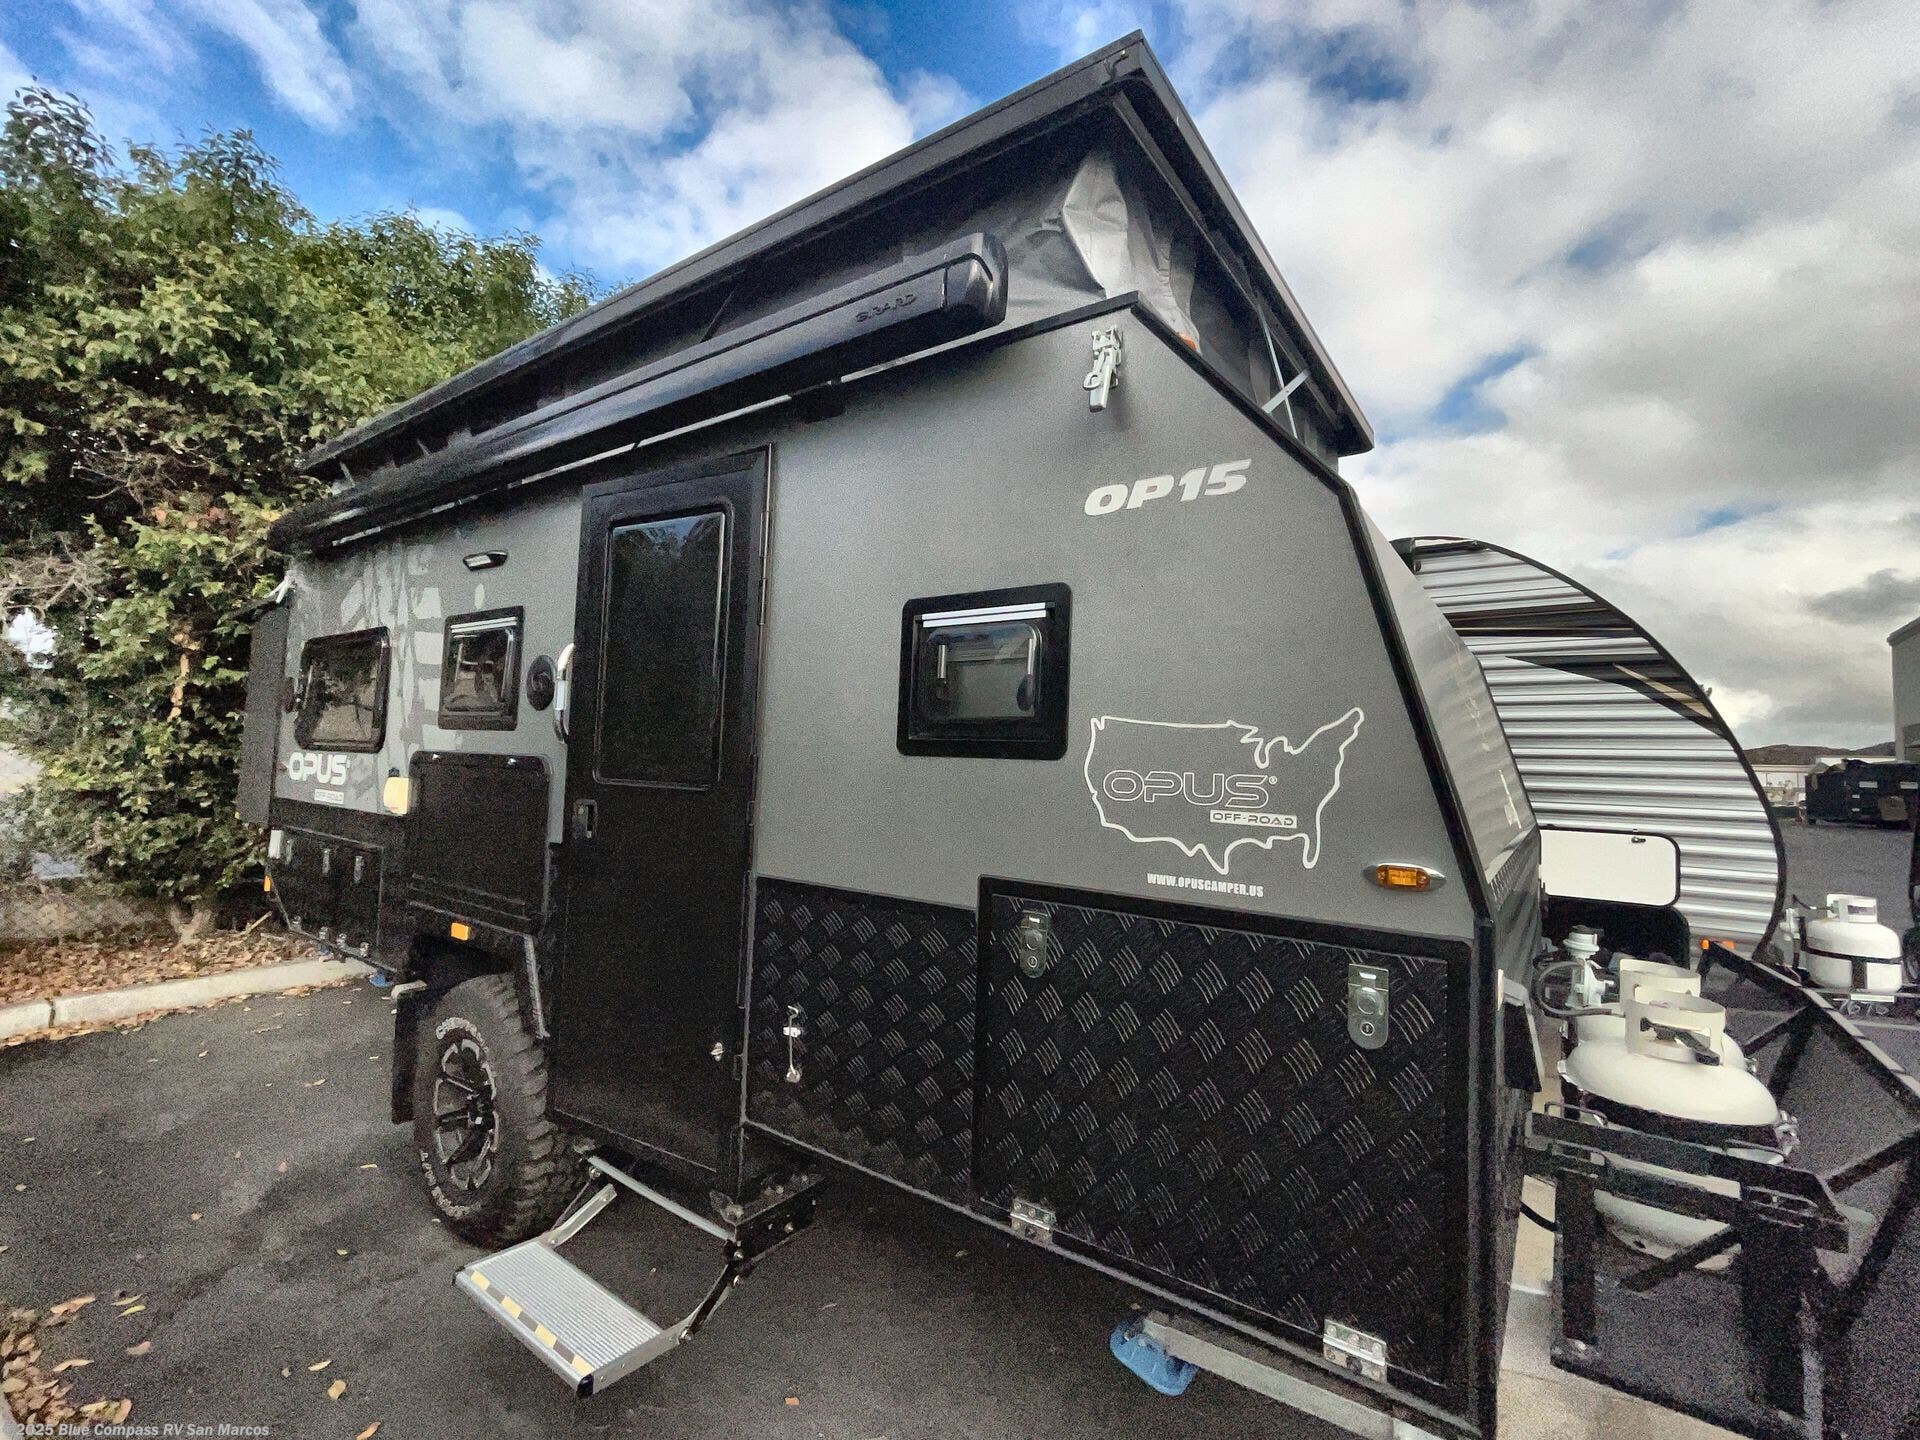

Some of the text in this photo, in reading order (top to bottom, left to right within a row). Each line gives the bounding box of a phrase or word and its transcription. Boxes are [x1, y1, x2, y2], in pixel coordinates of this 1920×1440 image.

[1084, 458, 1252, 516] OP15
[289, 752, 347, 785] OPUS
[1212, 812, 1295, 826] OFF-ROAD
[1146, 873, 1264, 897] WWW.OPUSCAMPER.US
